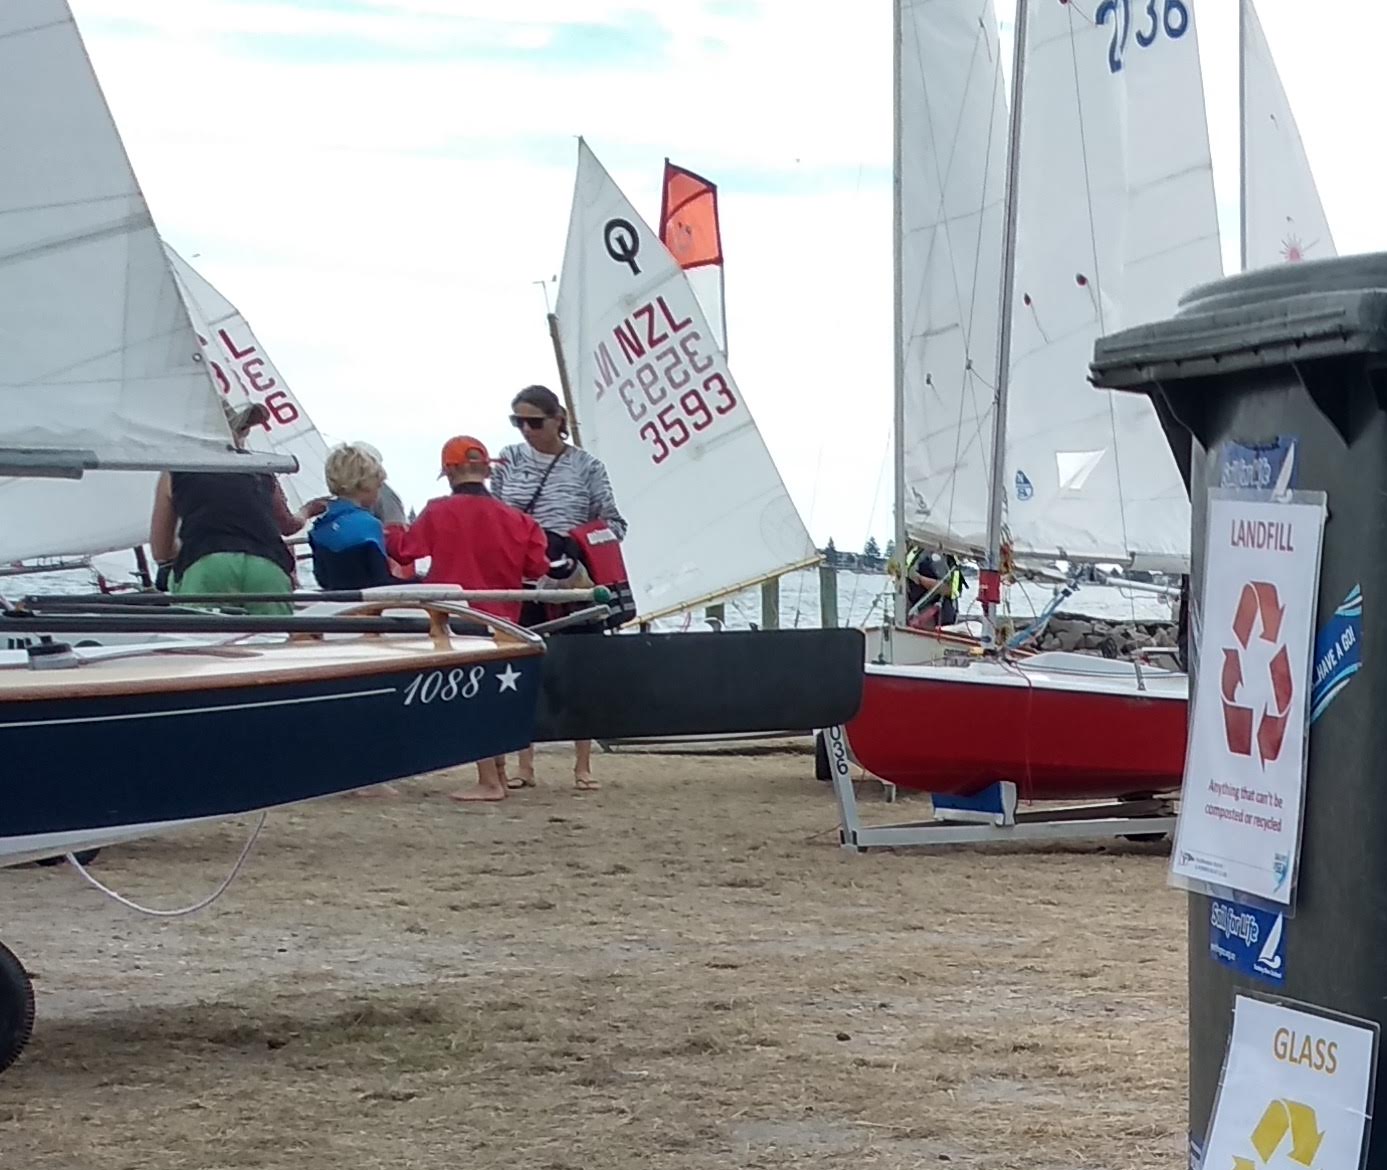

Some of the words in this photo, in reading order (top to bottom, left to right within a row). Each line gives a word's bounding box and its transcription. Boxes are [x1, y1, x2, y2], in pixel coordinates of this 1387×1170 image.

[613, 296, 692, 364] NZL
[640, 372, 737, 464] 3593
[1231, 519, 1294, 552] LANDFILL
[1335, 642, 1344, 661] A
[1341, 625, 1356, 652] GO!
[403, 665, 485, 705] 1088
[1208, 778, 1240, 801] Anything
[1240, 786, 1256, 802] that
[1273, 792, 1284, 809] be
[1204, 804, 1244, 823] composted
[1244, 813, 1253, 825] or
[1253, 816, 1282, 833] recycled
[1274, 1027, 1338, 1074] GLASS
